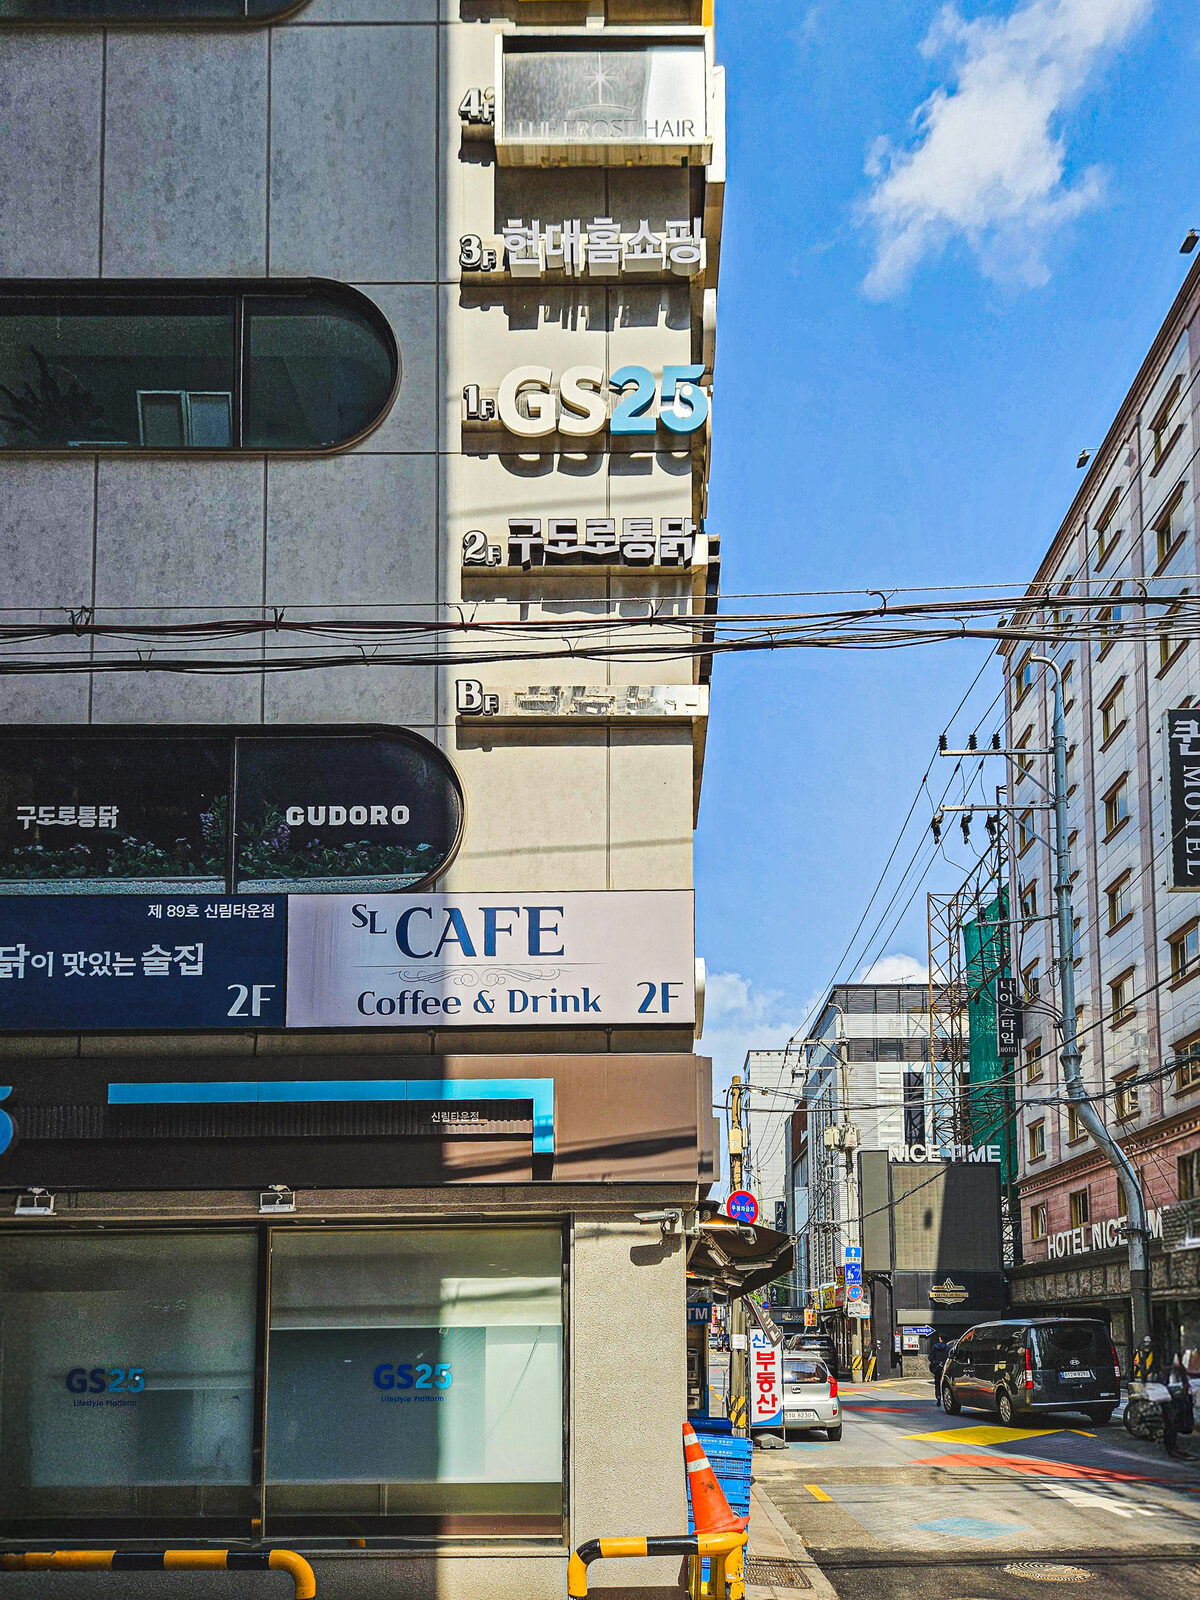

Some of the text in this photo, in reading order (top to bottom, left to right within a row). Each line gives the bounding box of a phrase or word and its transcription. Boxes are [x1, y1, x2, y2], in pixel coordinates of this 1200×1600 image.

[563, 119, 638, 138] FROST
[644, 119, 696, 138] HAIR
[459, 217, 702, 272] 3F 현대홈쇼핑
[463, 364, 708, 437] 1F GS25
[462, 517, 698, 569] 2F 구도로통닭
[456, 679, 499, 715] BF
[16, 805, 120, 830] 구도로통닭
[285, 805, 411, 826] GUDORO
[147, 903, 275, 919] 제 89호 신림타운점
[351, 903, 565, 959] SL CAFE
[0, 942, 204, 979] 닭이 맛있는 술집
[226, 984, 276, 1017] 2F
[357, 987, 602, 1016] Coffee & Drink
[636, 981, 684, 1014] 2F
[1000, 980, 1016, 1044] 나이스타임
[431, 1111, 479, 1123] 신림타운점
[888, 1144, 1002, 1163] NICE TIME
[1047, 1226, 1090, 1260] HOTEL
[1092, 1215, 1129, 1251] NICE
[66, 1367, 145, 1393] GS25
[374, 1363, 453, 1390] GS25
[756, 1351, 778, 1414] 부동산
[106, 1399, 137, 1407] Platform
[413, 1394, 446, 1403] Platform
